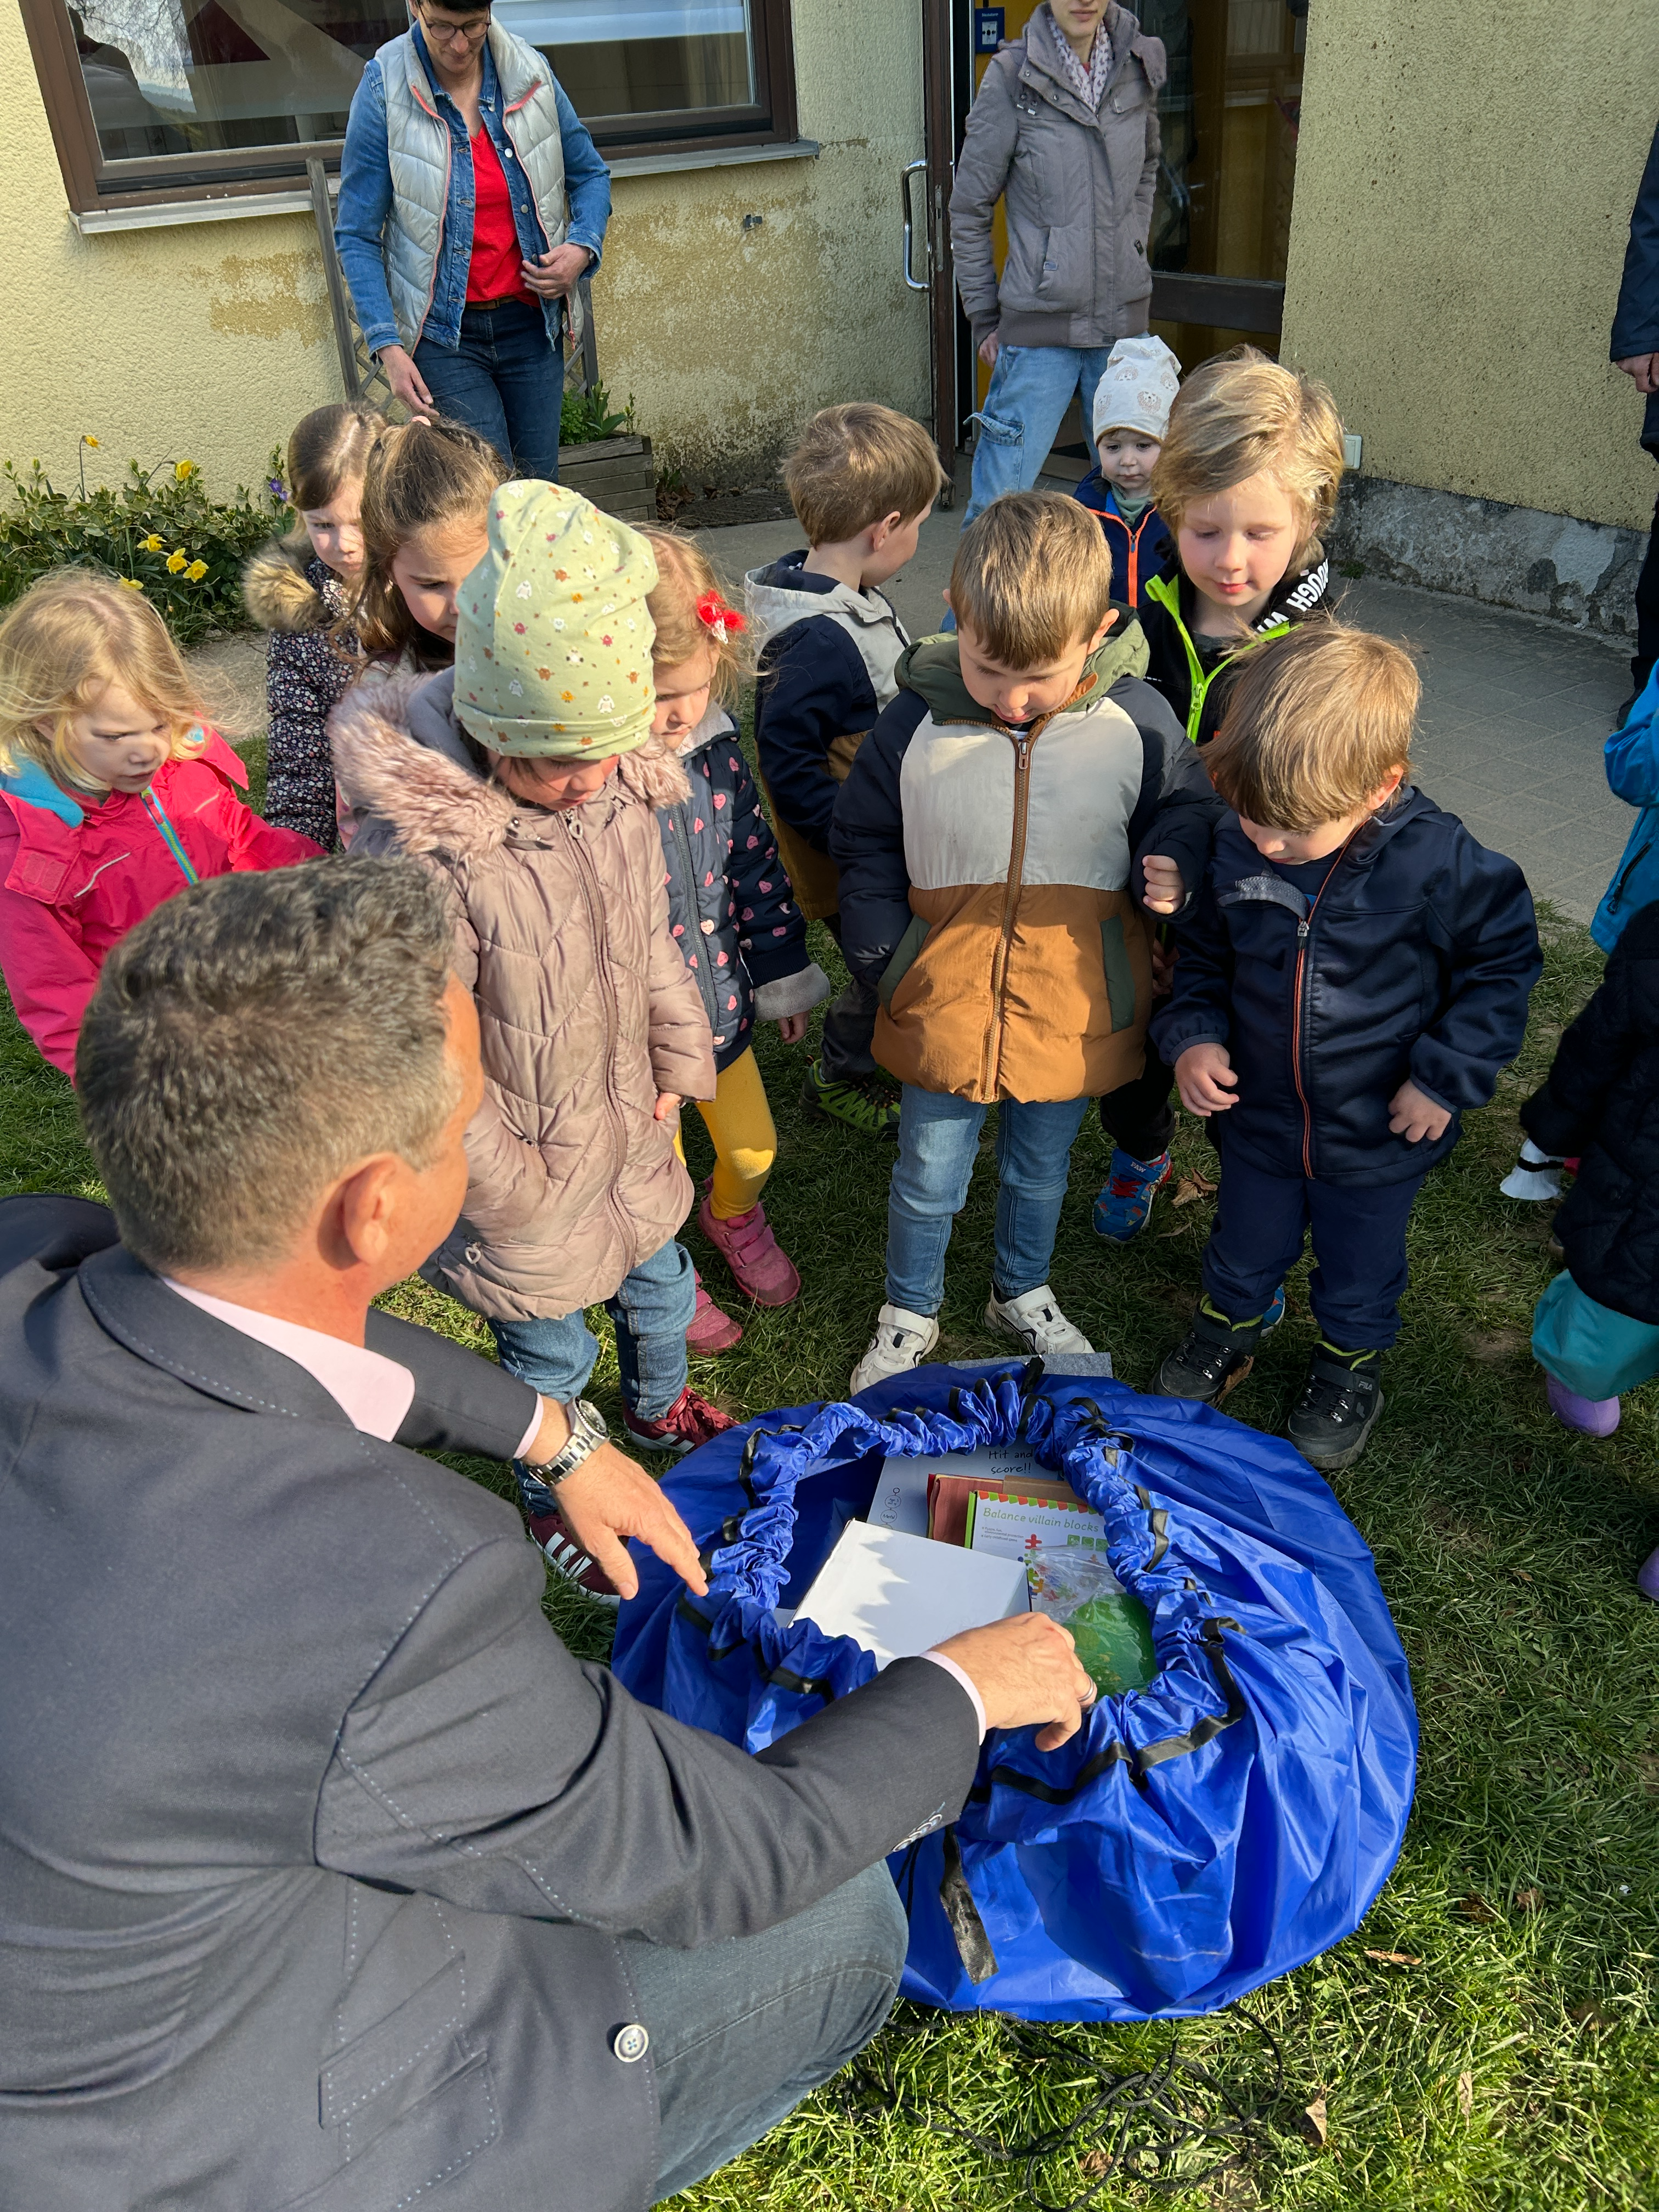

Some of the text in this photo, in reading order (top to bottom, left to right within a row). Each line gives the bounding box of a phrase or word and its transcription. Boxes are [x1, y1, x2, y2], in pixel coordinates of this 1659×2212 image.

[1131, 1161, 1146, 1172] PAW
[1358, 1380, 1372, 1391] FILA
[989, 1449, 1032, 1459] Hit and
[991, 1463, 1031, 1474] score!!
[983, 1507, 1099, 1532] Balance villain blocks
